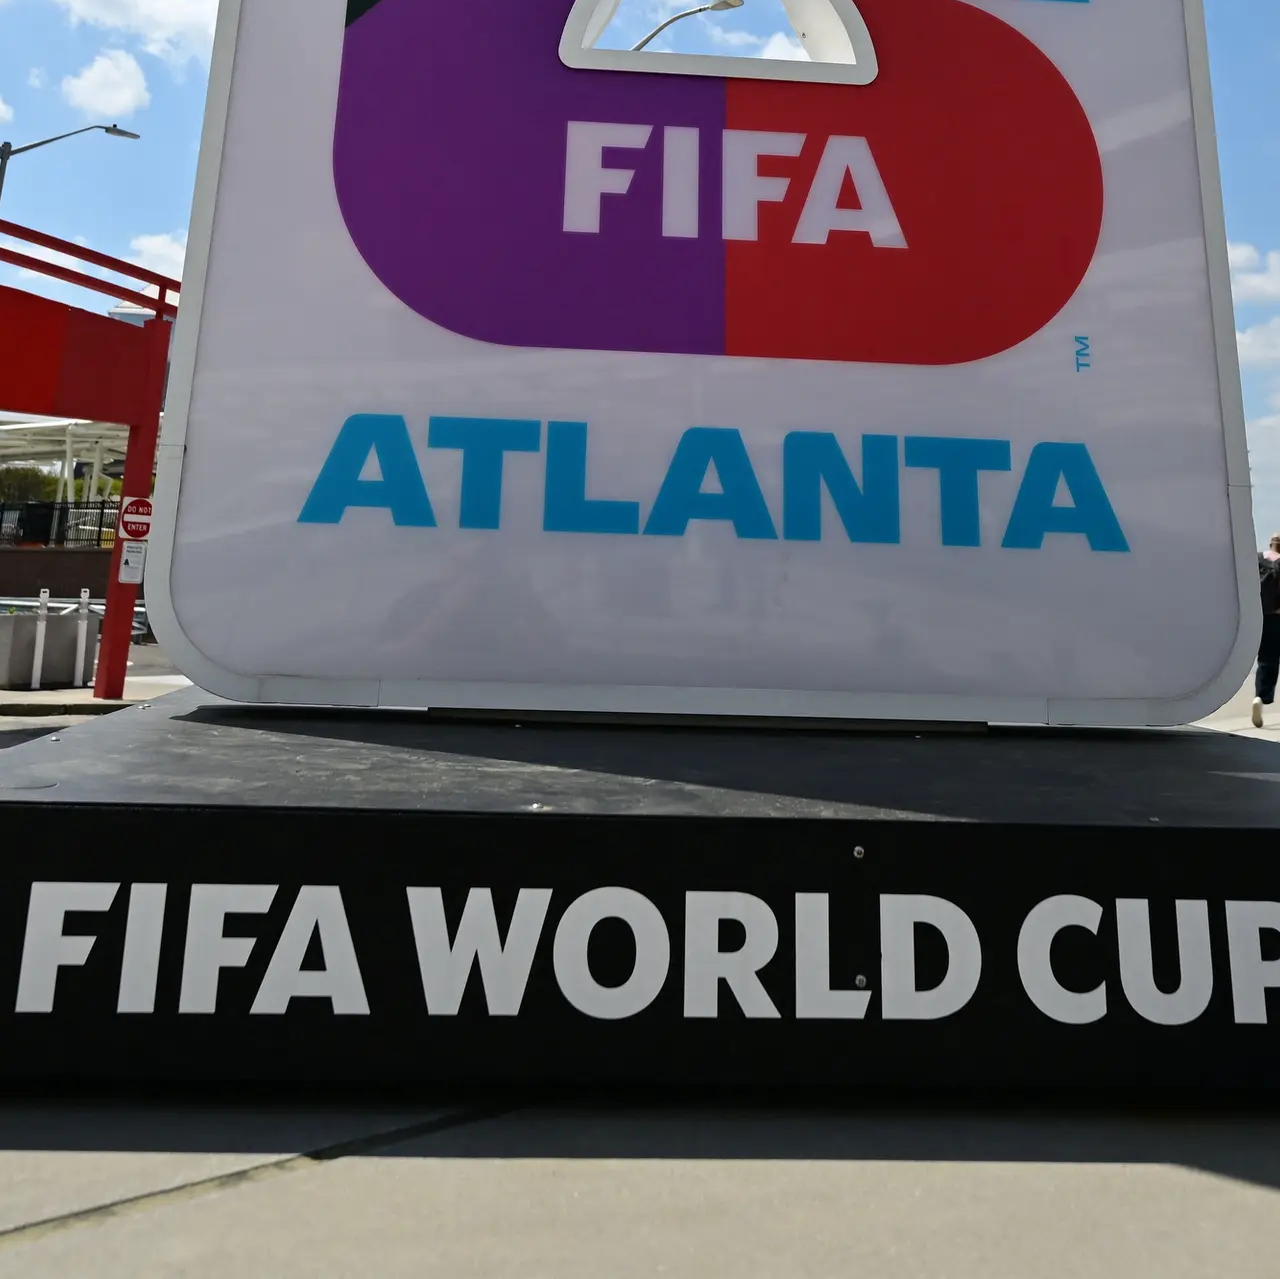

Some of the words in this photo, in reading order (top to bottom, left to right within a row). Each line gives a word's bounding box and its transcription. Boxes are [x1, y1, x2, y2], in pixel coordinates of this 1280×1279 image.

[562, 120, 908, 249] FIFA
[1074, 335, 1091, 373] TM
[127, 505, 137, 513] DO
[138, 505, 152, 514] NOT
[297, 413, 1131, 553] ATLANTA
[127, 523, 148, 531] ENTER
[15, 881, 371, 1015] FIFA
[405, 886, 982, 1020] WORLD
